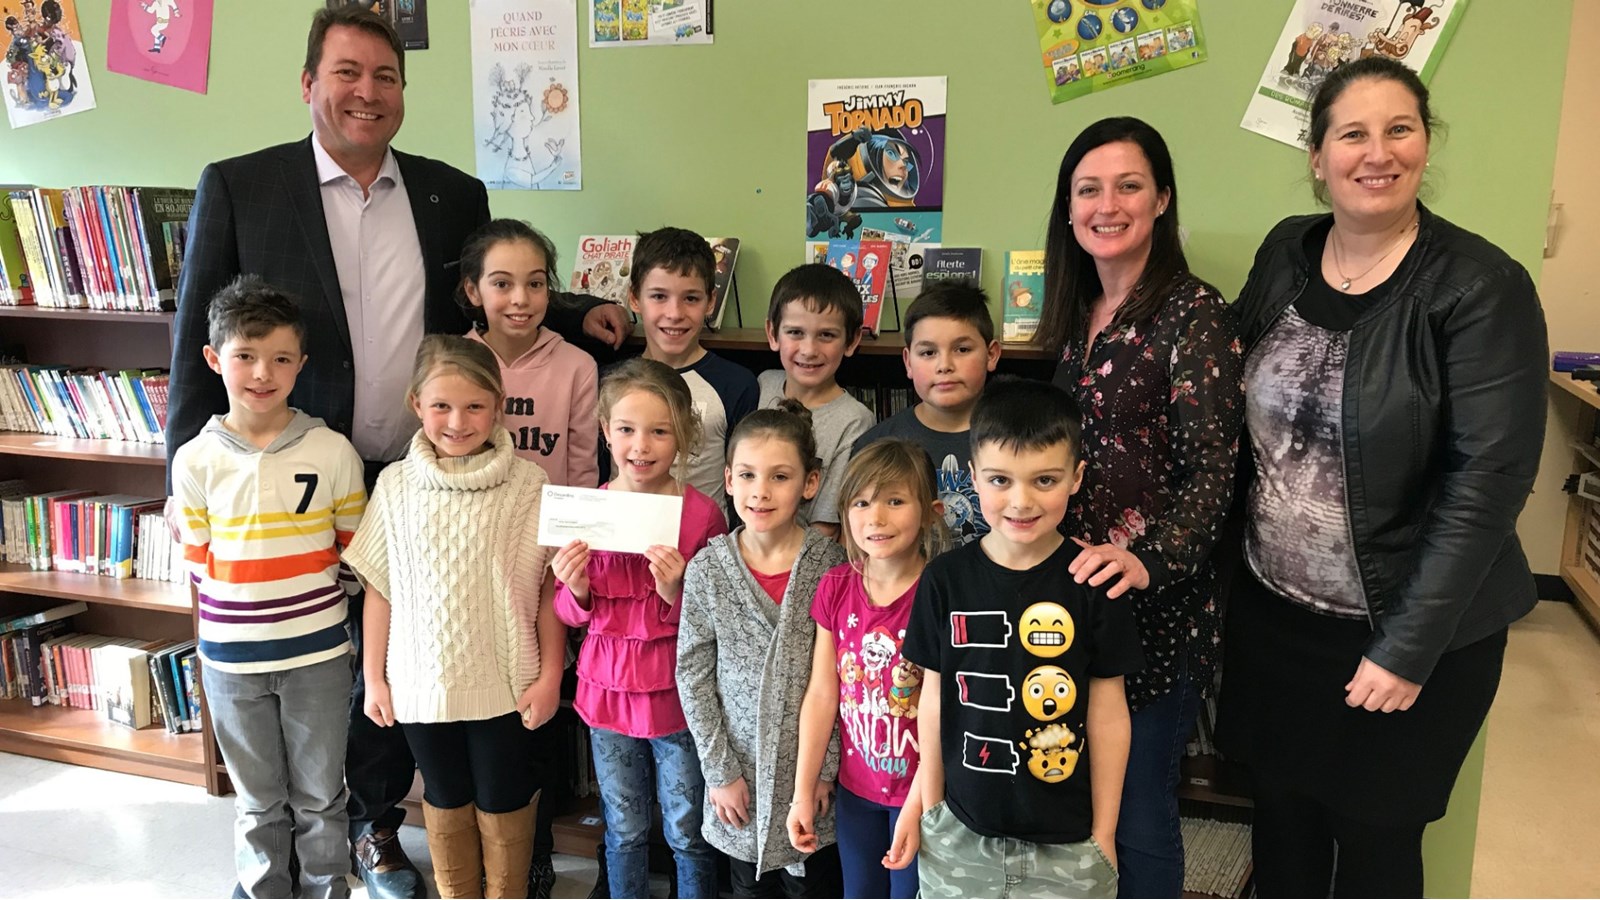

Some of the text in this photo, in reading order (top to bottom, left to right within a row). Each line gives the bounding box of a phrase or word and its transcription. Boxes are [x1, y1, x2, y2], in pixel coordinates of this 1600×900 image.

[503, 11, 542, 24] QUAND
[529, 25, 557, 36] AVEC
[494, 42, 518, 51] MON
[824, 99, 923, 136] TORNADO
[165, 204, 175, 213] 80
[582, 237, 632, 252] Goliath
[604, 251, 629, 259] PIRATE
[294, 473, 319, 515] 7
